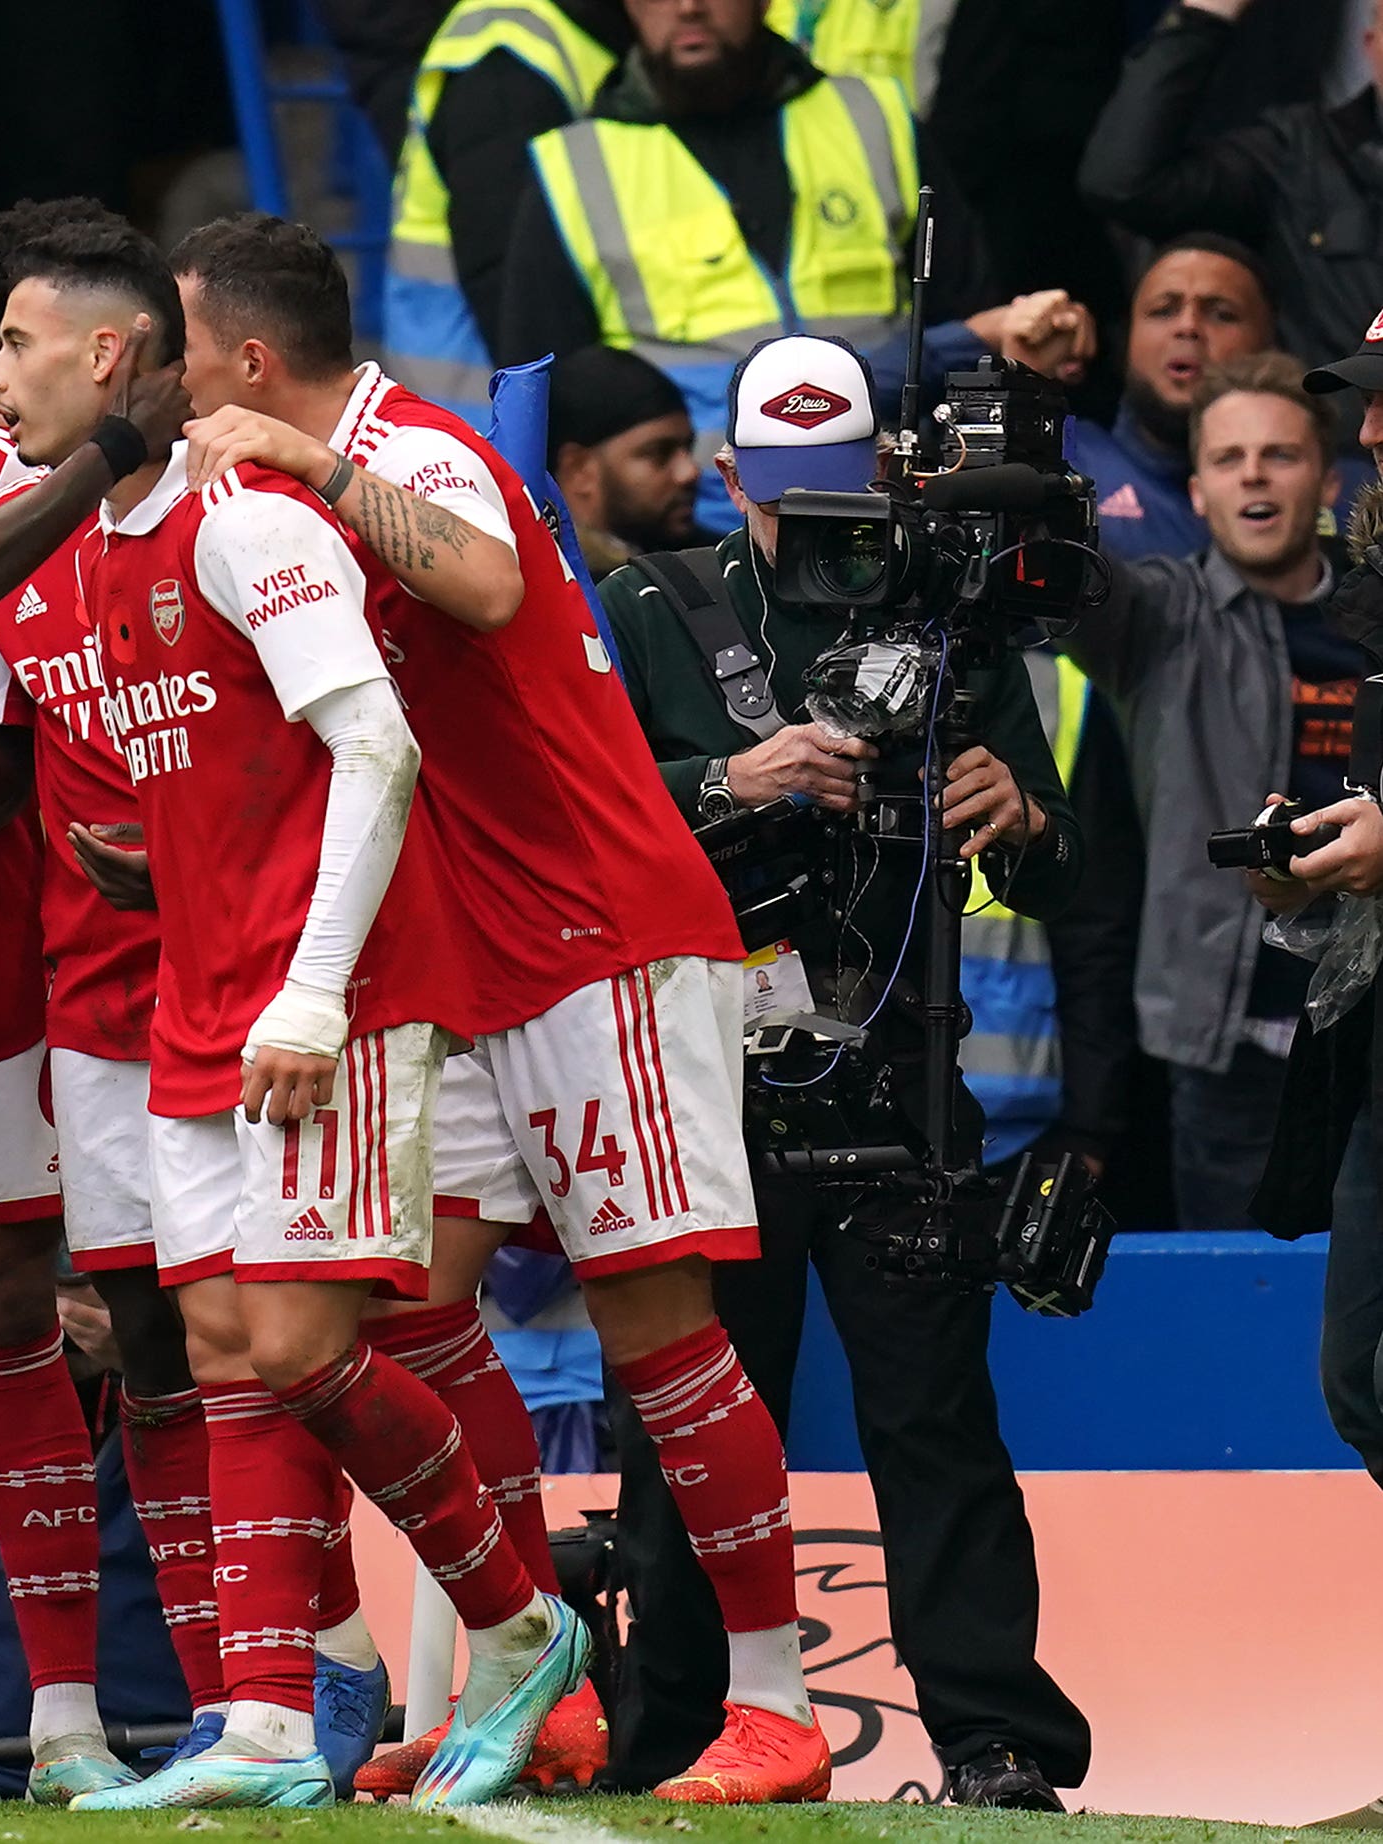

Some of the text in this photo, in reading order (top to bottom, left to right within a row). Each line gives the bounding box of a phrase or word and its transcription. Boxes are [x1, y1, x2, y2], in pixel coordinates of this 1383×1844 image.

[780, 394, 831, 415] Deus
[402, 461, 452, 492] VISIT
[252, 564, 308, 598] VISIT
[245, 580, 340, 631] RWANDA
[282, 1109, 339, 1200] 11
[528, 1098, 628, 1198] 34
[284, 1226, 334, 1241] adidas
[588, 1215, 636, 1237] adidas
[660, 1463, 710, 1487] FC
[22, 1505, 97, 1528] AFC
[148, 1540, 207, 1563] AFC
[212, 1564, 249, 1588] FC
